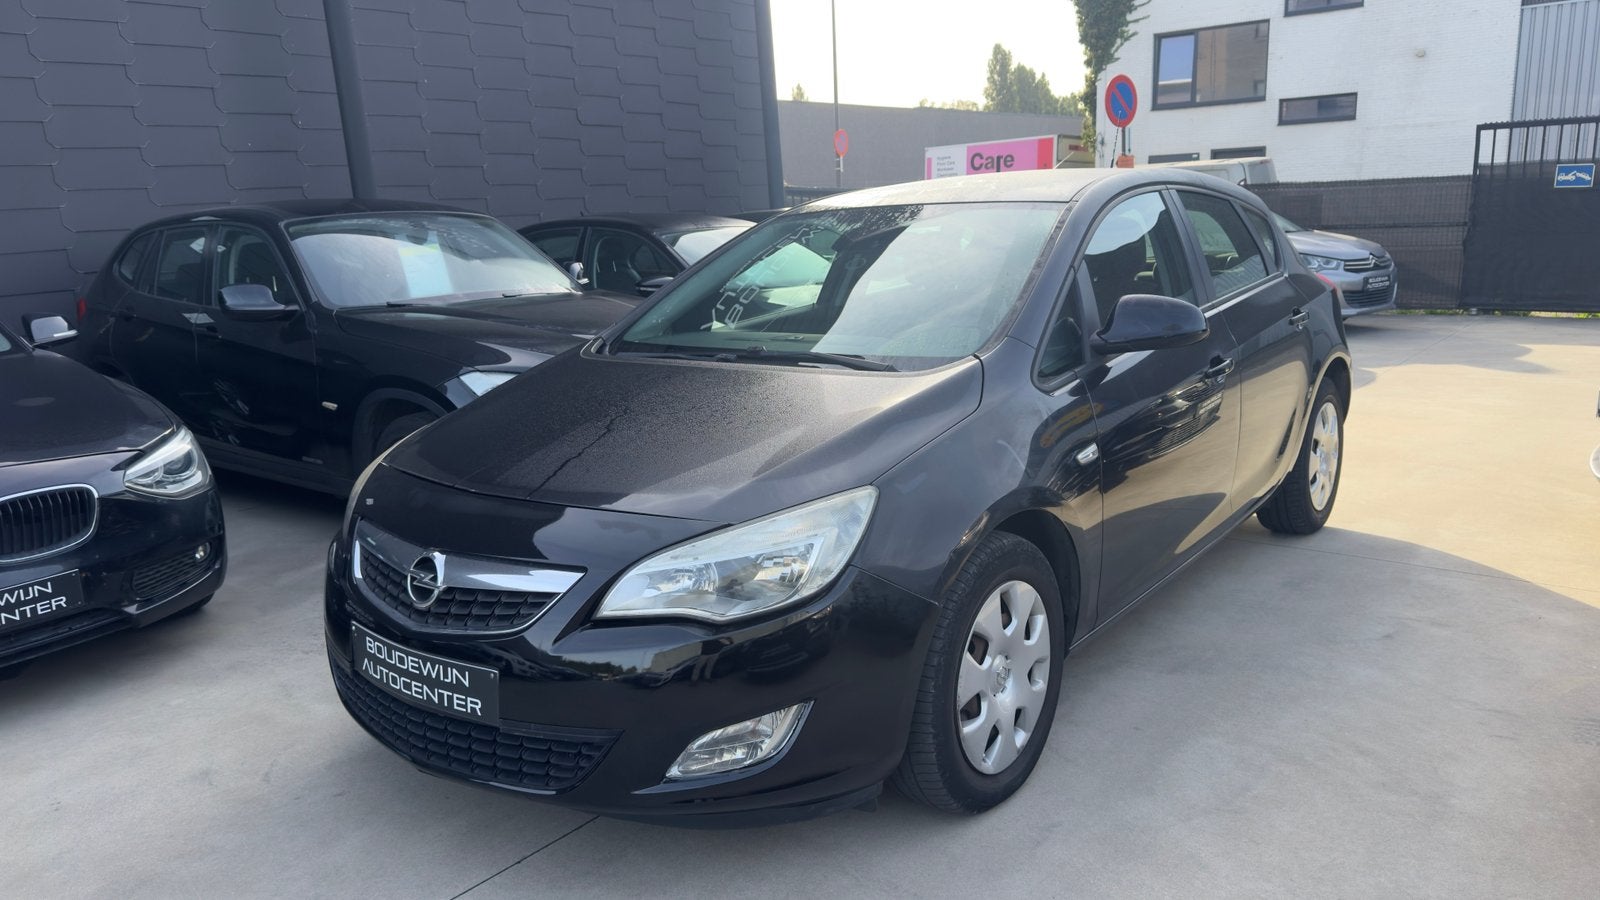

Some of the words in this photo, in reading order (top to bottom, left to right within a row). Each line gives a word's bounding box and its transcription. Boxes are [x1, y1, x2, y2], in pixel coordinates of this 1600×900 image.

[970, 153, 1015, 172] Care
[362, 657, 482, 716] AUTOCENTER
[366, 636, 470, 688] BOUDEWIJN
